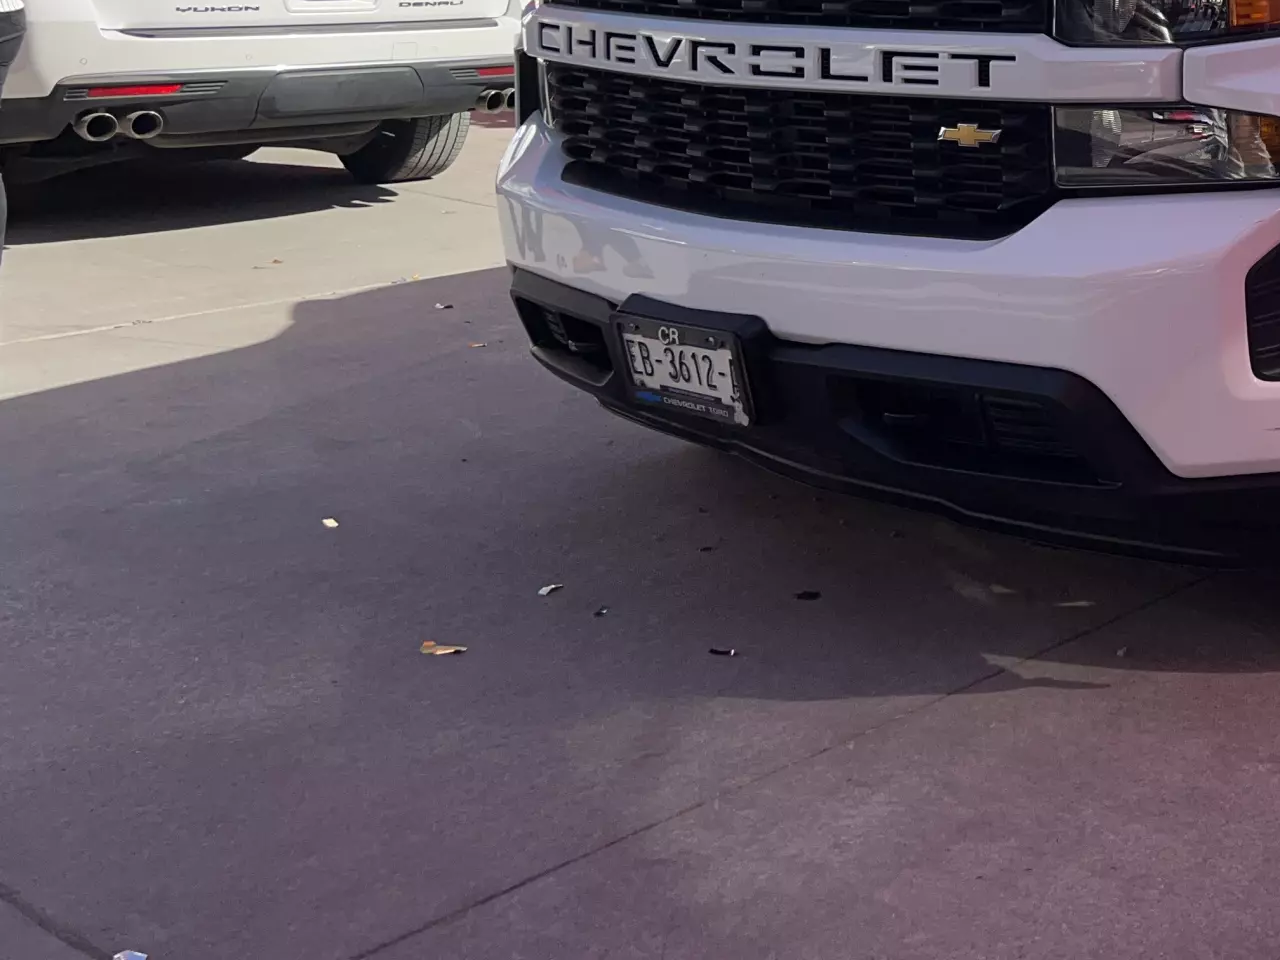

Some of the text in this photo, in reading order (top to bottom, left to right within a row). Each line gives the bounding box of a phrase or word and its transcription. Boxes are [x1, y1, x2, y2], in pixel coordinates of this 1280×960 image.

[175, 5, 260, 13] YUKON
[398, 0, 464, 8] DENALI
[538, 22, 1017, 88] CHEVROLET
[658, 326, 679, 345] CR
[663, 396, 706, 412] CHEVROLET
